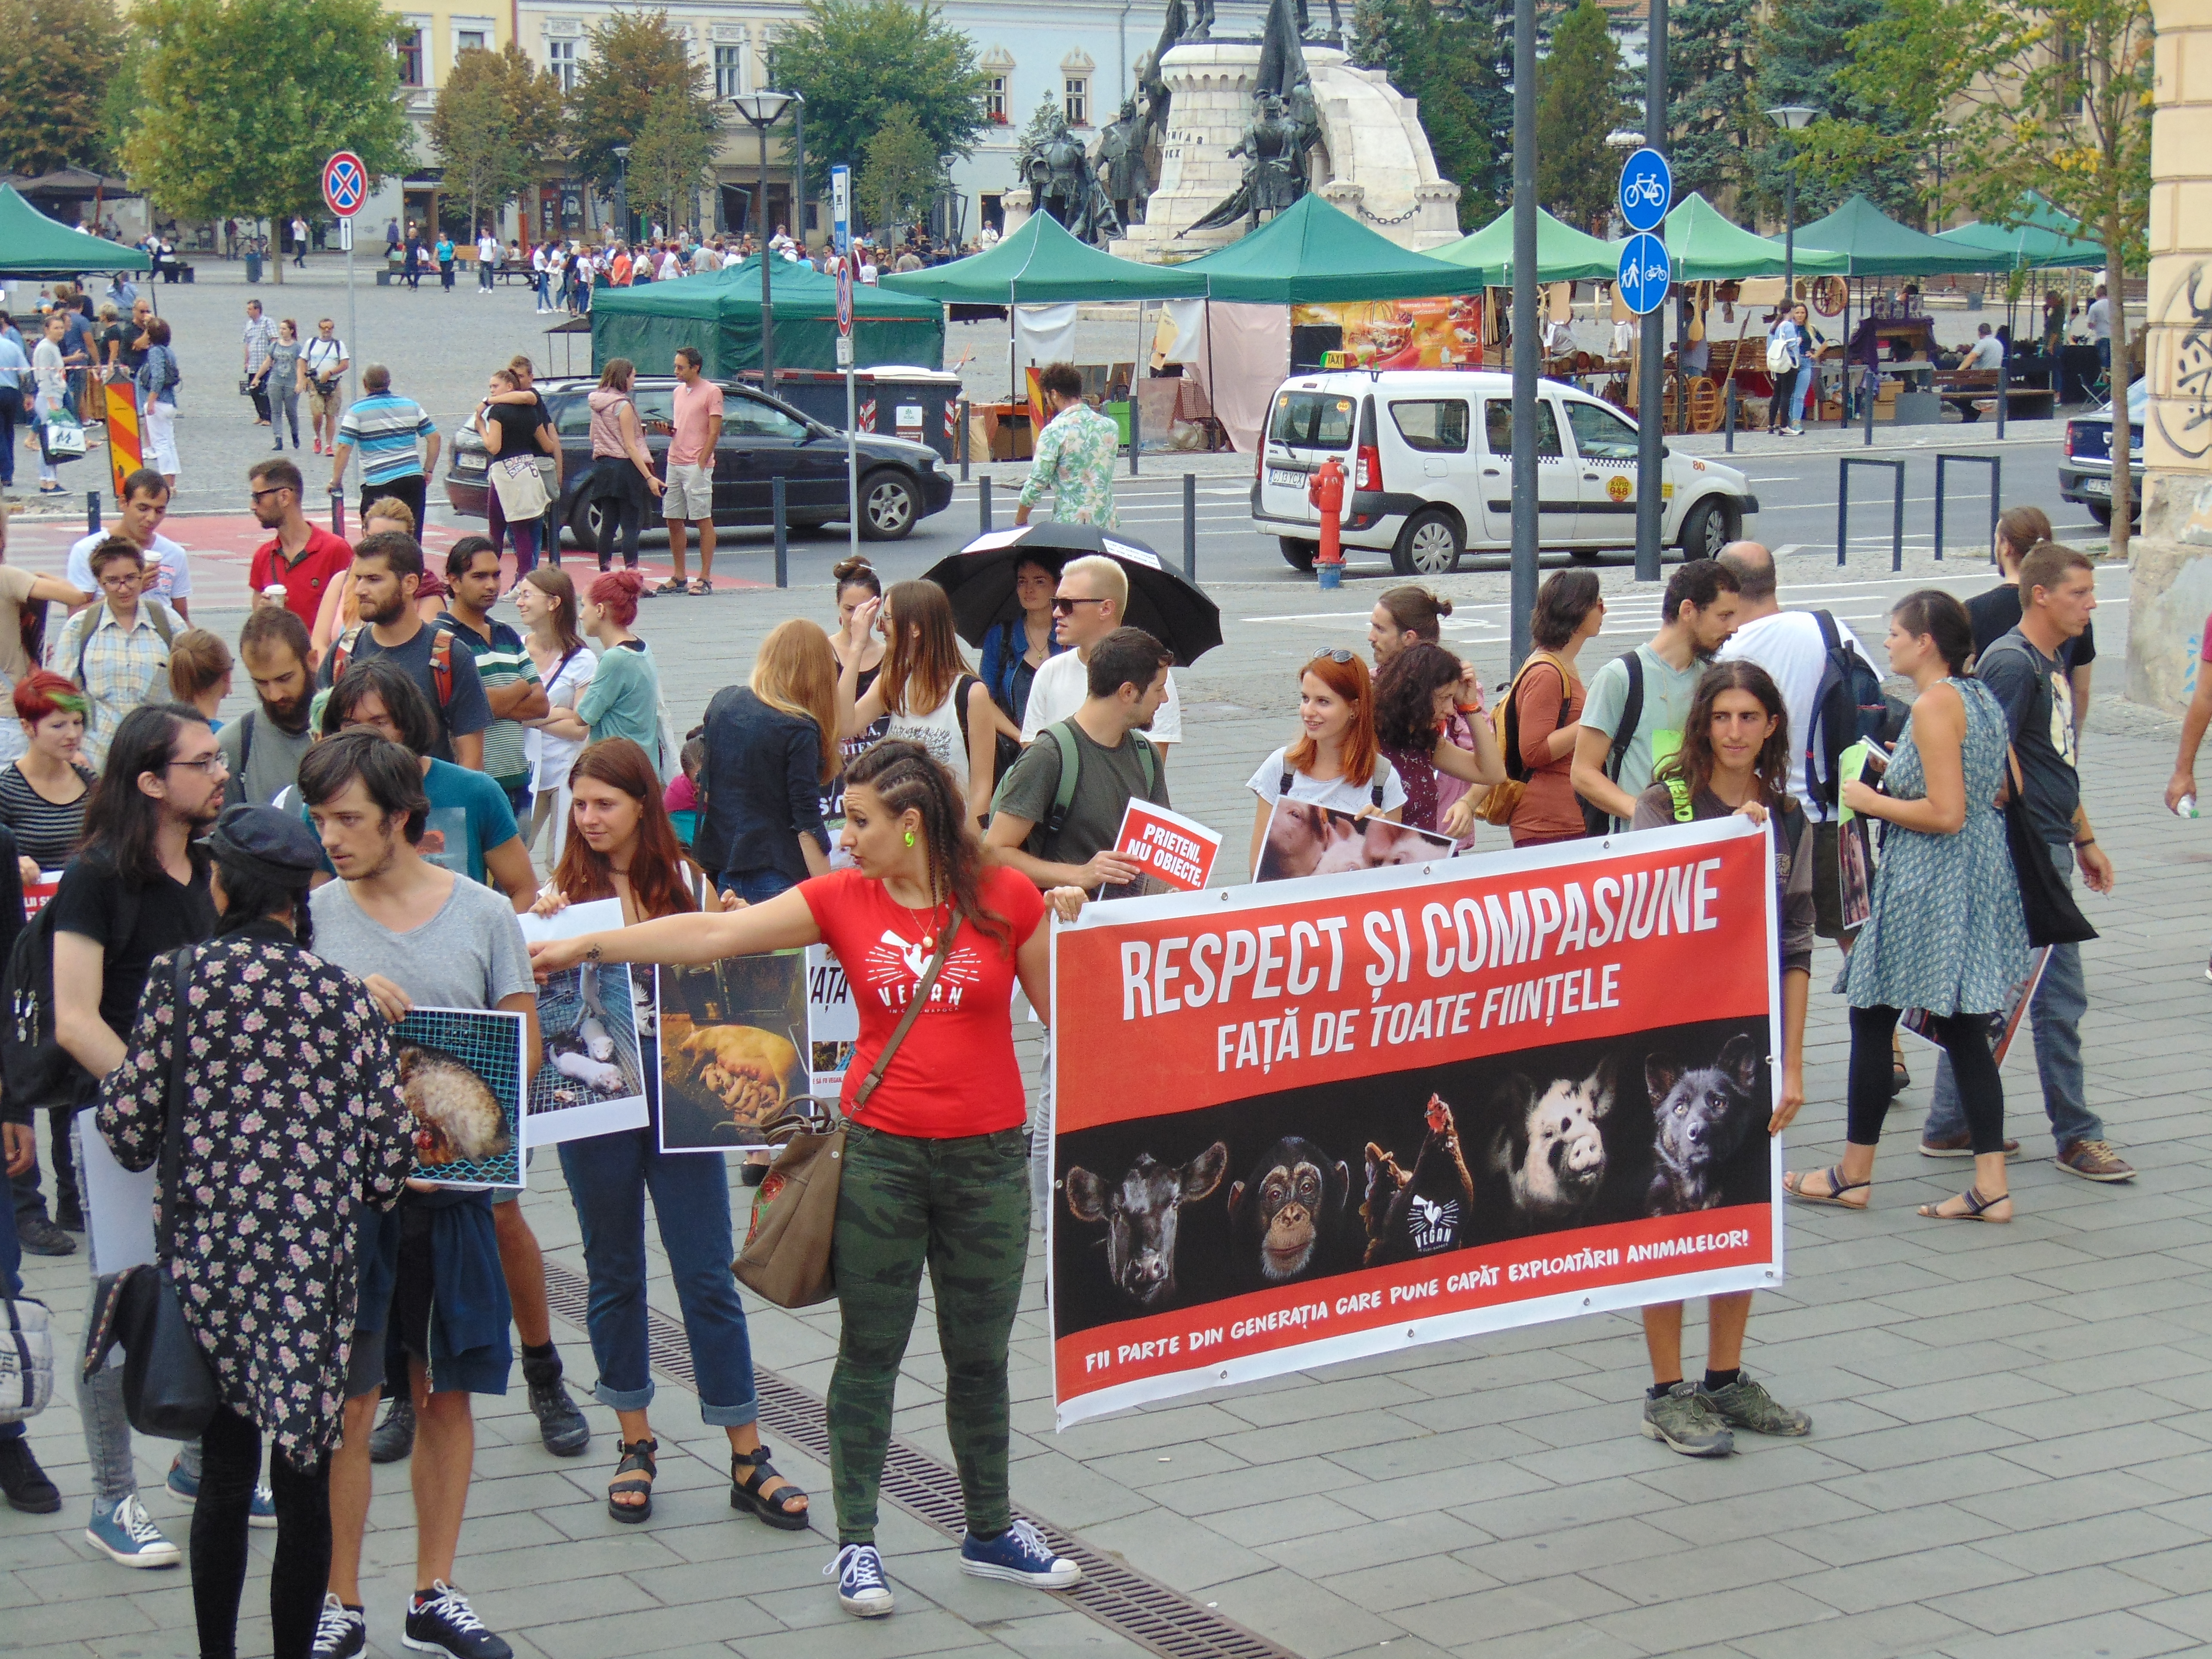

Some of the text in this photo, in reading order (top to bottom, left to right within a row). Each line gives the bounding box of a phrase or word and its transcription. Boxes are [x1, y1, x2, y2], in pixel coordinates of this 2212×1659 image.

[1328, 353, 1344, 365] TAXI
[1273, 471, 1303, 484] CJ 13 YCX
[1692, 460, 1706, 471] 80
[1610, 486, 1629, 495] 948
[1142, 823, 1201, 864] PRIETENI.
[1126, 839, 1203, 888] NU OBIECTE.
[1121, 858, 1720, 1020] RESPECT ȘI COMPASIUNE
[1218, 963, 1620, 1074] FAȚĂ DE TOATE FIINȚELE
[1415, 1228, 1451, 1248] VEGAN
[1085, 1229, 1748, 1373] FII PARTE DIN GENERAȚIA CARE PUNE CAPĂT EXPLOATĂRII ANIMALELOR!
